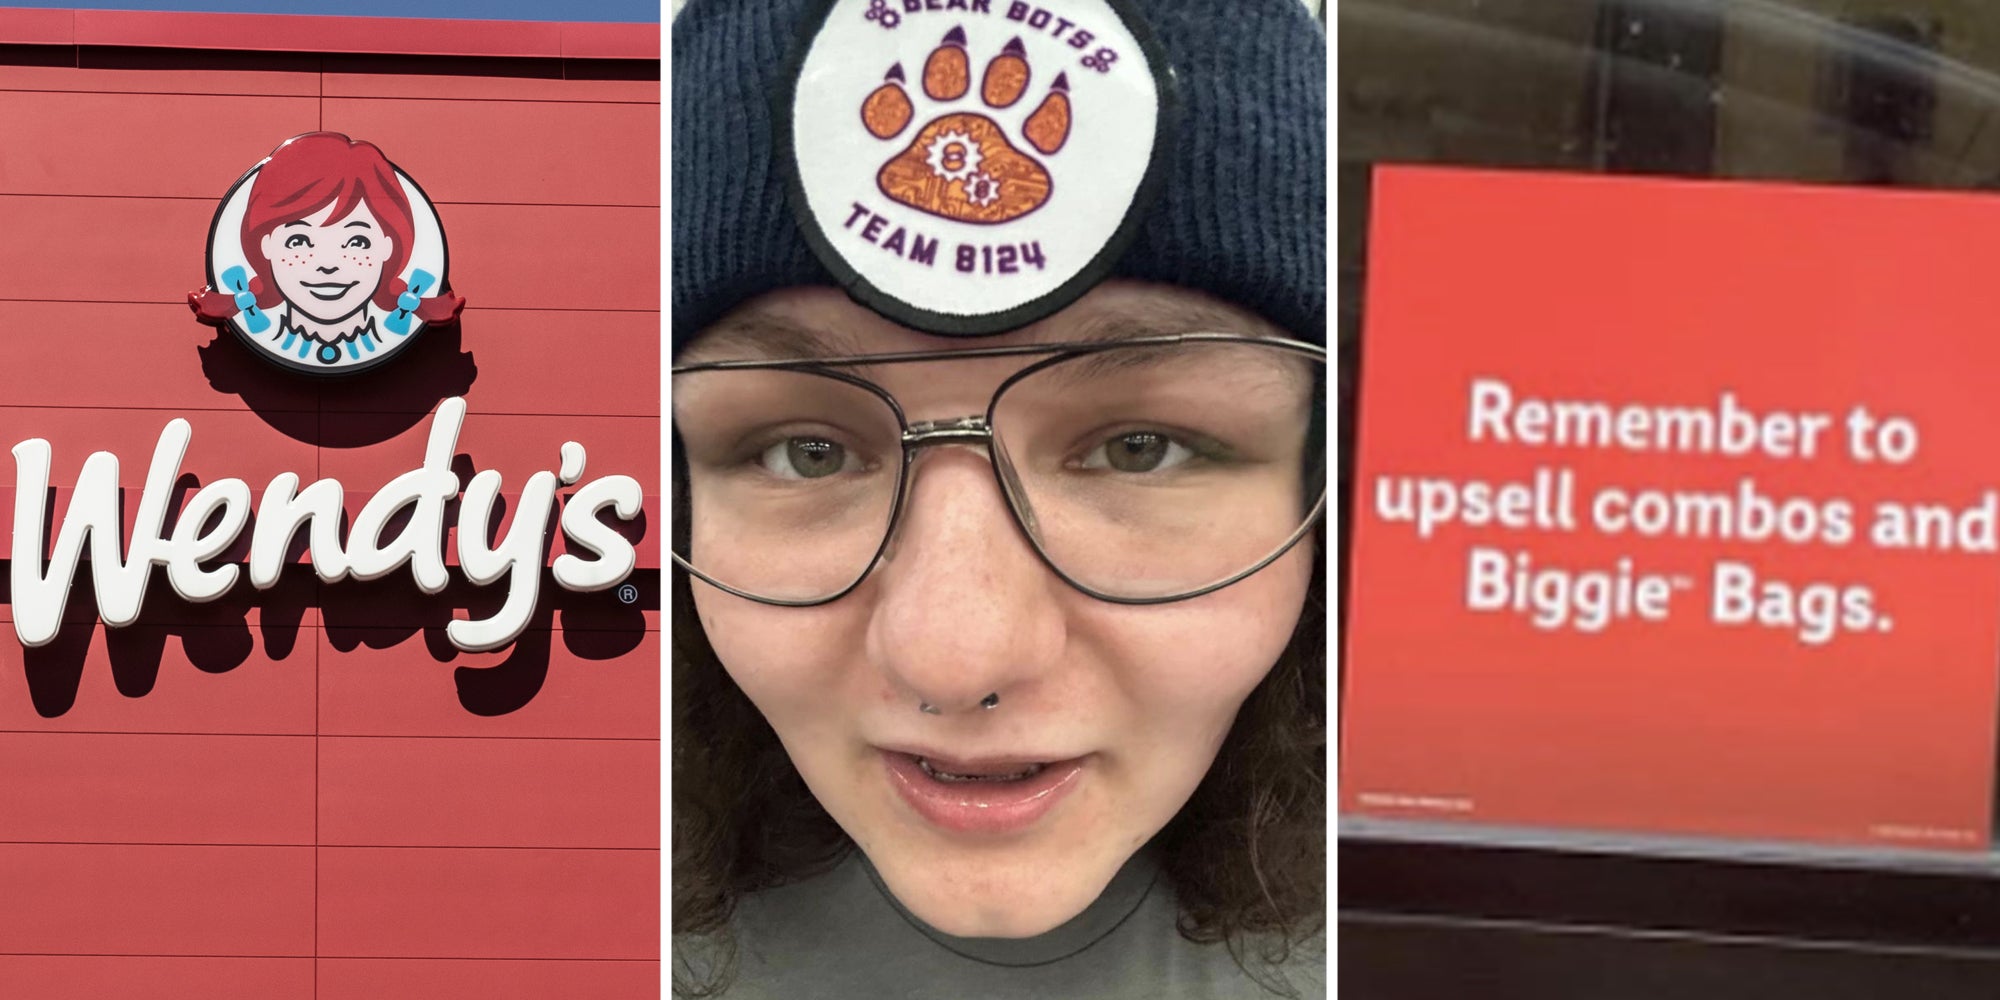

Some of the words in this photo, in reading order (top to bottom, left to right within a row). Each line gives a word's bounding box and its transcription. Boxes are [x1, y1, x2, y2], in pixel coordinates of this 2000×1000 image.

[1006, 0, 1096, 49] BOTS
[843, 202, 939, 266] TEAM
[955, 241, 1046, 274] 8124
[1468, 379, 1830, 458] Remember
[1848, 405, 1918, 462] to
[11, 396, 643, 652] Wendy's
[1375, 469, 1576, 539] upsell
[1592, 480, 1855, 545] combos
[1871, 490, 1999, 552] and
[1712, 560, 1893, 645] Bags.
